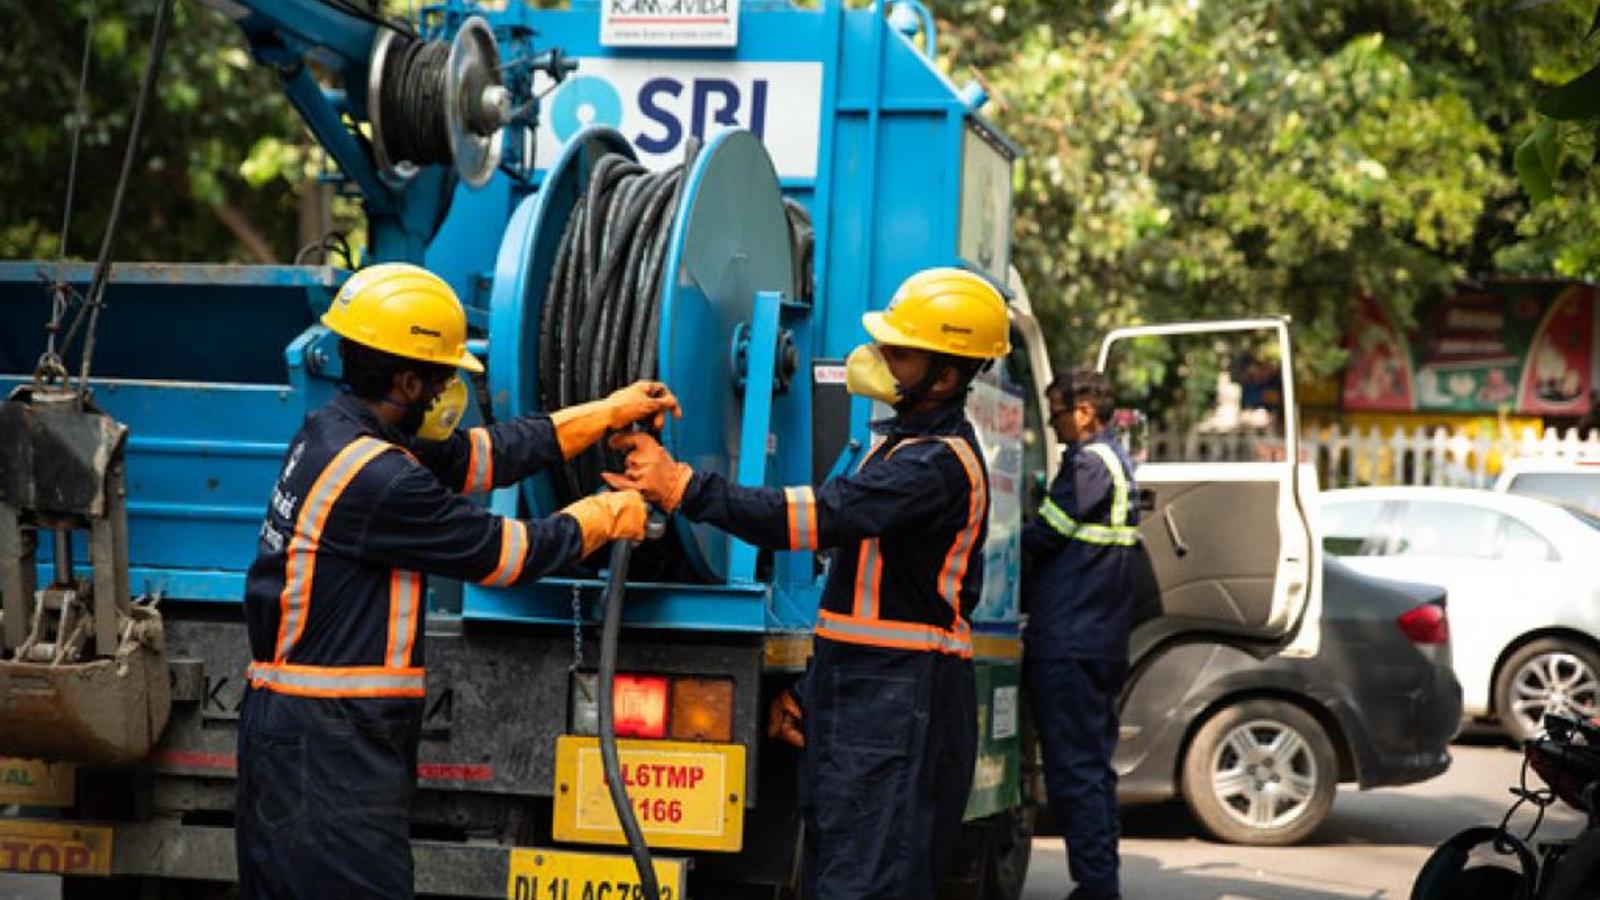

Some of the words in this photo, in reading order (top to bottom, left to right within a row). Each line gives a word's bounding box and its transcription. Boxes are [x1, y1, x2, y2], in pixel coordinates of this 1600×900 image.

[635, 77, 769, 154] SBI
[603, 763, 704, 789] L6TMP
[628, 798, 682, 823] 166
